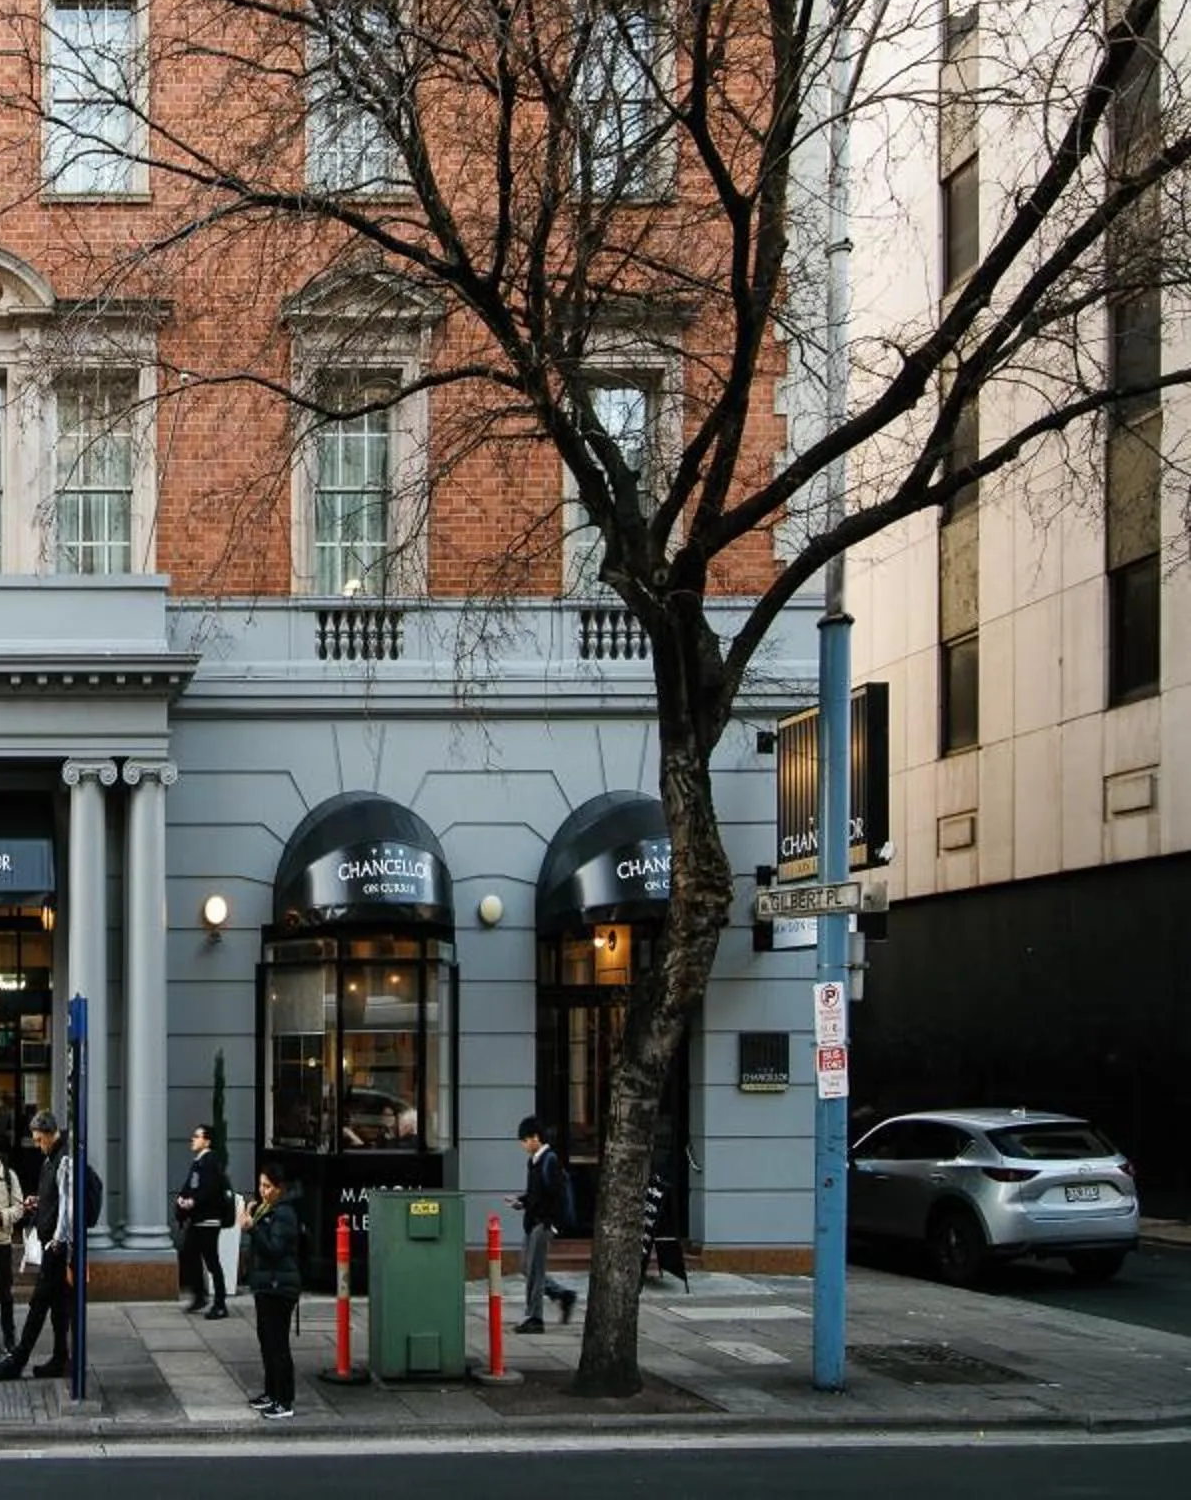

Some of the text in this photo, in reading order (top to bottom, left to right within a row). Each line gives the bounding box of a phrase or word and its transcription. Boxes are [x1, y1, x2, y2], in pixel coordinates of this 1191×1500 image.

[362, 883, 378, 895] ON
[771, 888, 824, 911] GILBERT
[826, 888, 842, 905] PL
